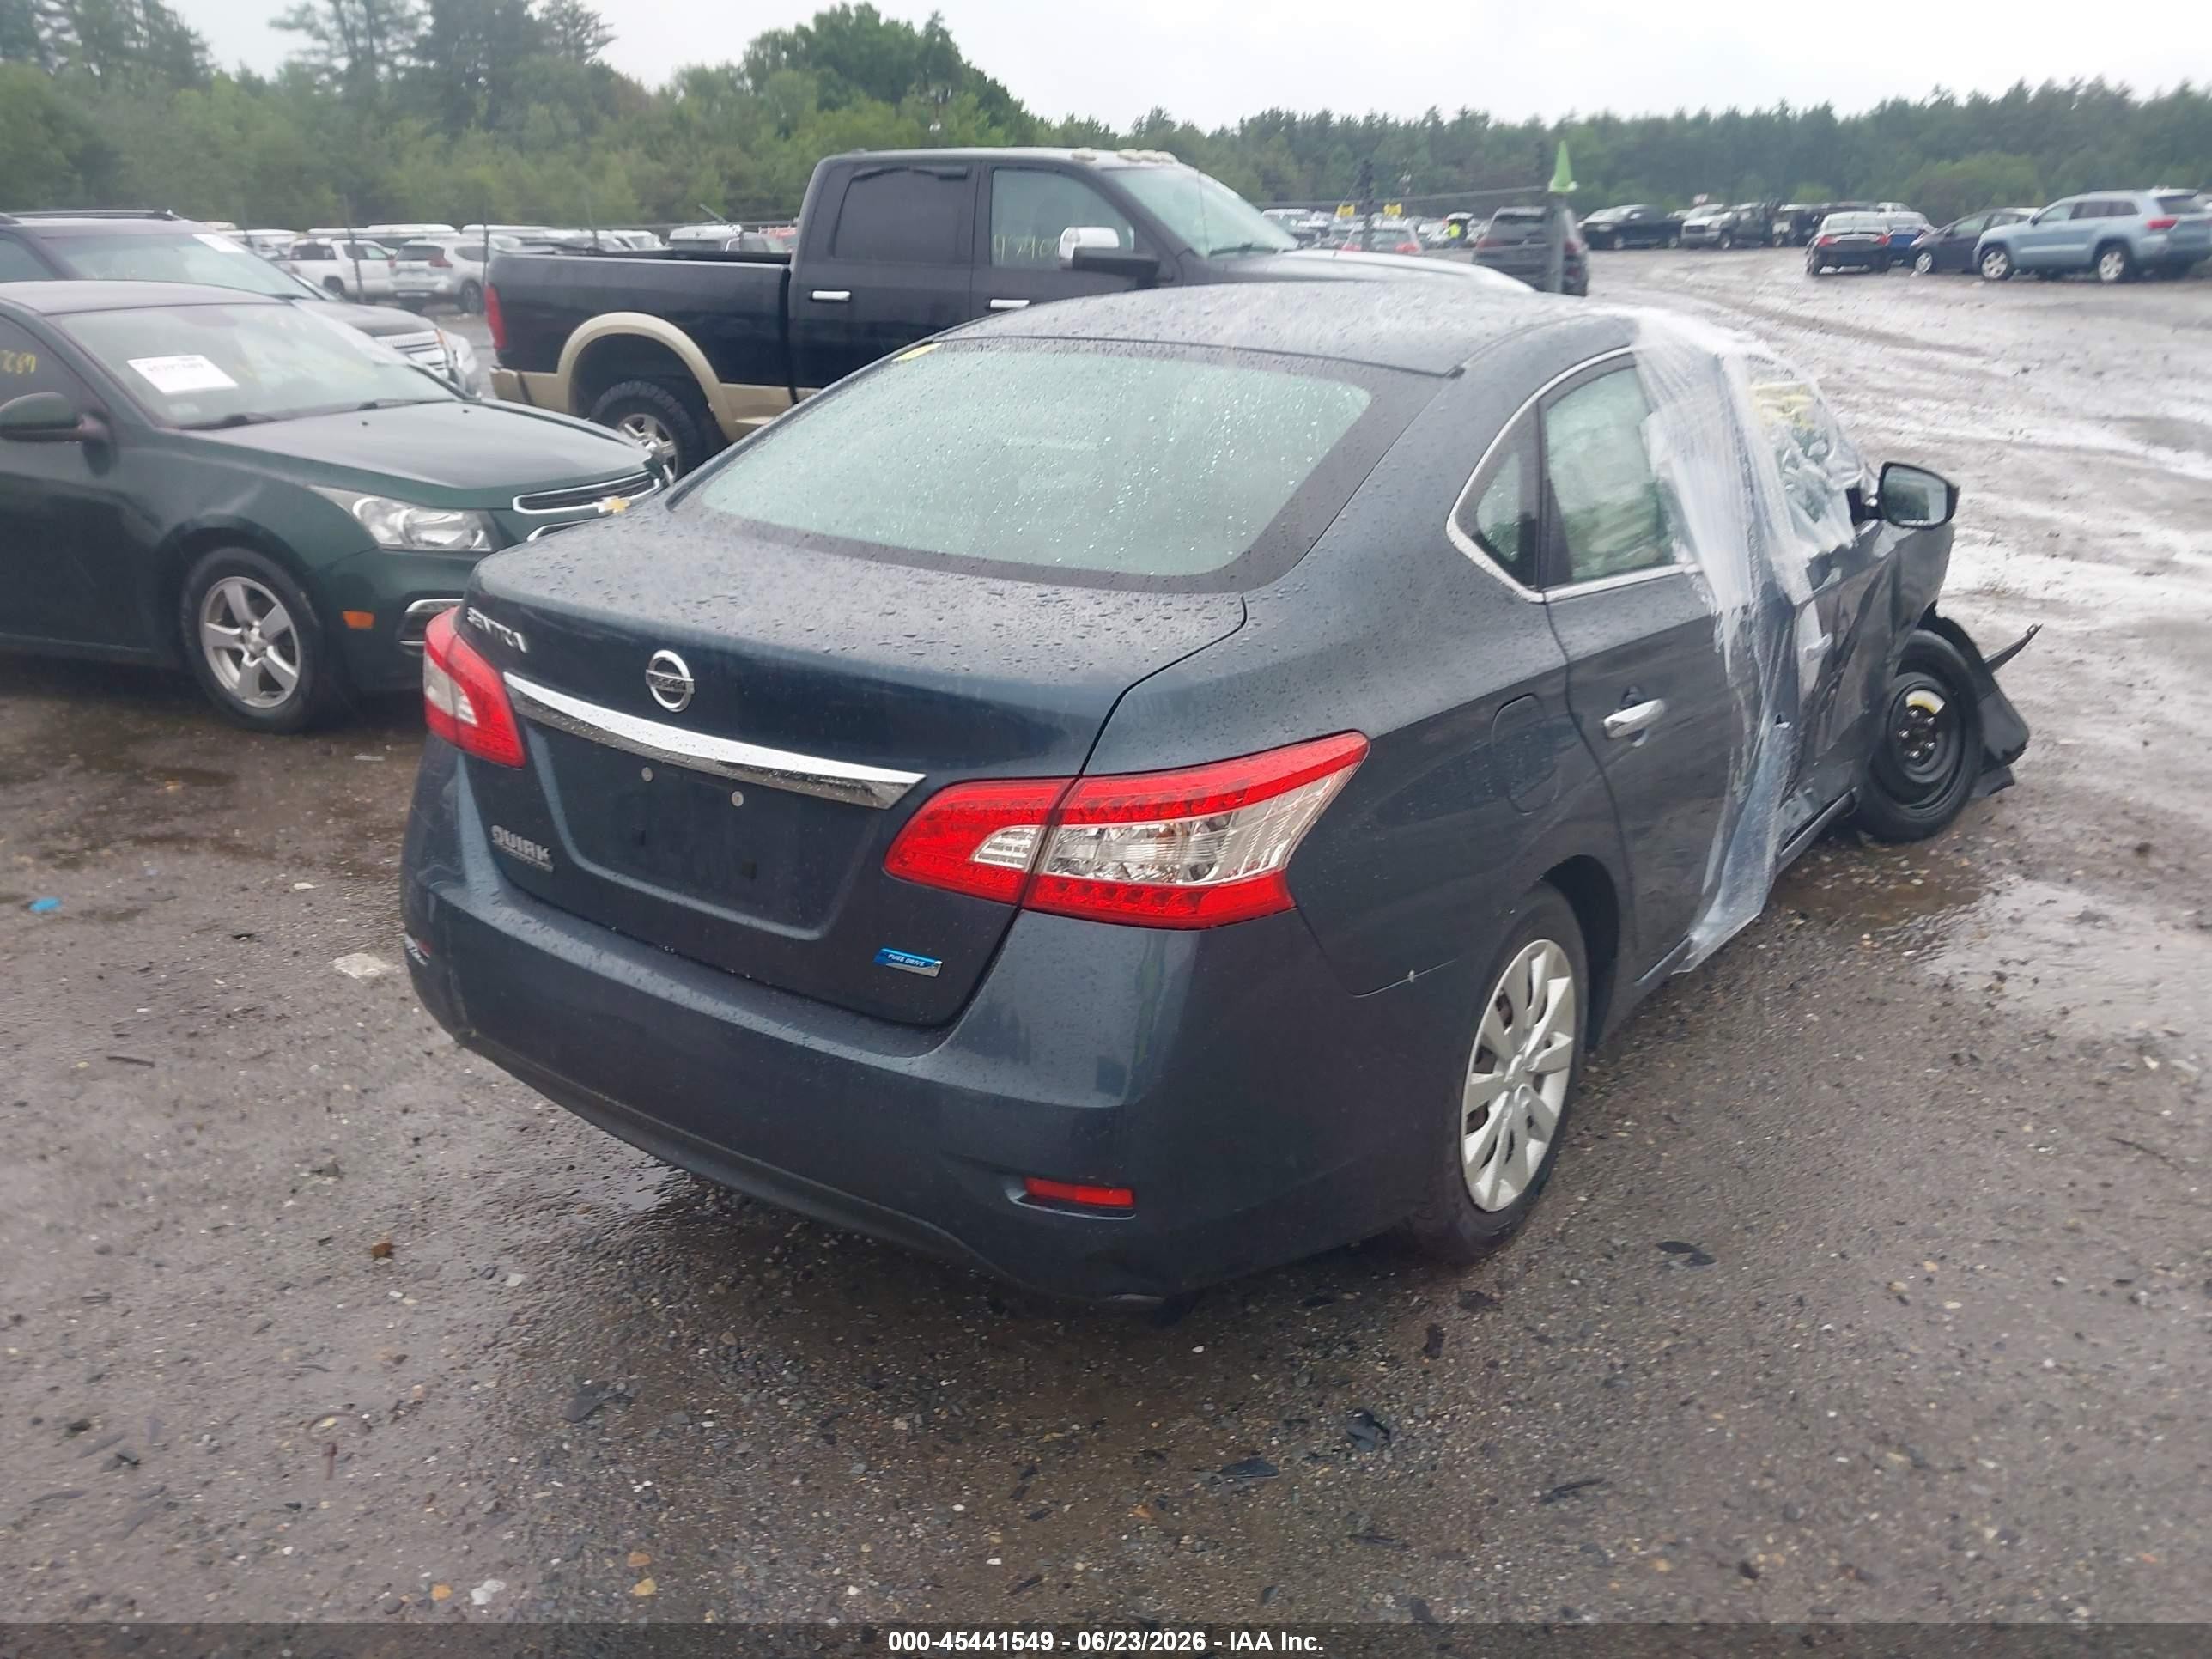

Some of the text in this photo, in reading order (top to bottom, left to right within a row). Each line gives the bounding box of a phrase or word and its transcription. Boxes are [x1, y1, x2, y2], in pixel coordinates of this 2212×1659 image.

[491, 824, 550, 864] QUIRK
[887, 953, 926, 967] PURE DRIVE
